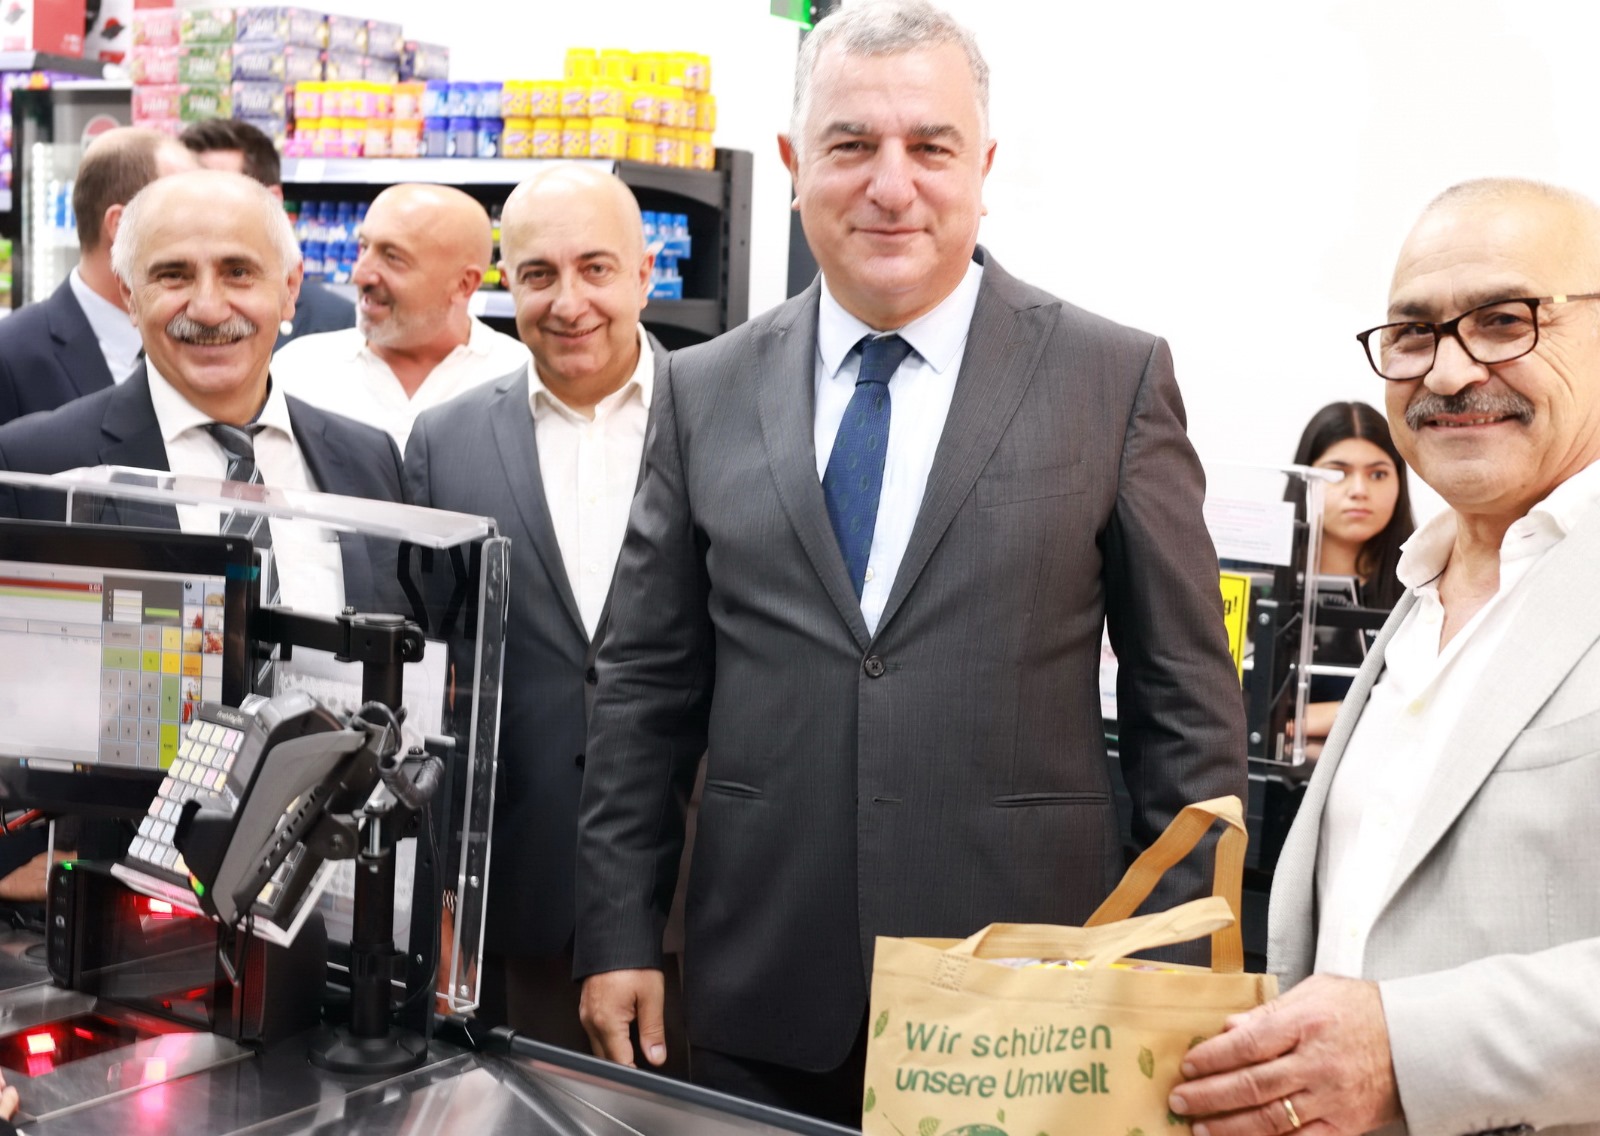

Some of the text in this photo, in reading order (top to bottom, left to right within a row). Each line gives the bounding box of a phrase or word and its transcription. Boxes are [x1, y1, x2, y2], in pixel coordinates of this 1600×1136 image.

[906, 1021, 1112, 1058] Wir schützen
[895, 1062, 1110, 1099] unsere Umwelt
